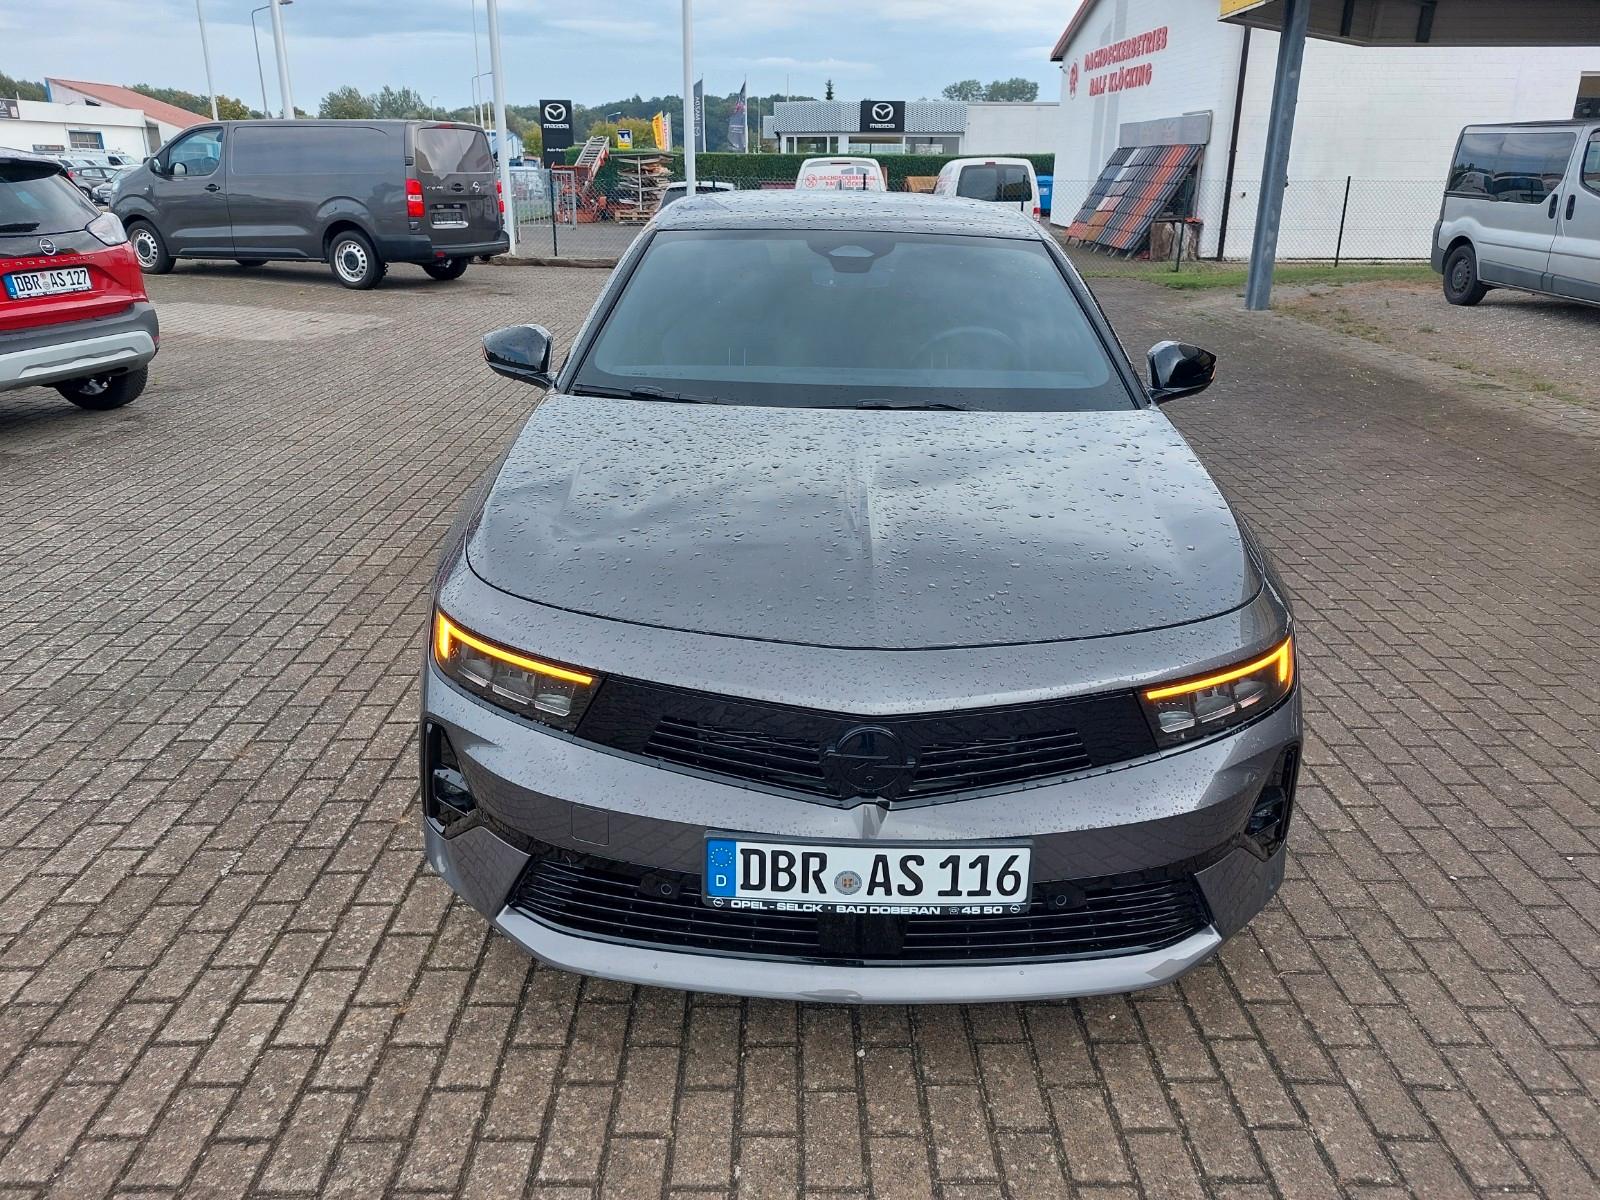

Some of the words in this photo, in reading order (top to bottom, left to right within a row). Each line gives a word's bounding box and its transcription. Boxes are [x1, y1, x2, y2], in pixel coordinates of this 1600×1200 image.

[1084, 26, 1168, 72] DACHDECKERBETRIEB
[1089, 74, 1107, 96] RALF
[1108, 62, 1152, 93] KLÖCKING
[14, 274, 42, 292] DBR
[50, 272, 67, 287] AS
[67, 269, 87, 286] 127
[715, 874, 727, 887] D
[740, 848, 828, 895] DBR
[866, 854, 925, 897] AS
[938, 855, 1022, 897] 116
[730, 899, 768, 910] OPEL
[776, 902, 823, 913] SELCK
[836, 905, 867, 914] BAD
[869, 905, 941, 915] DOBERAN
[961, 906, 980, 914] 45
[983, 906, 1003, 914] 50
